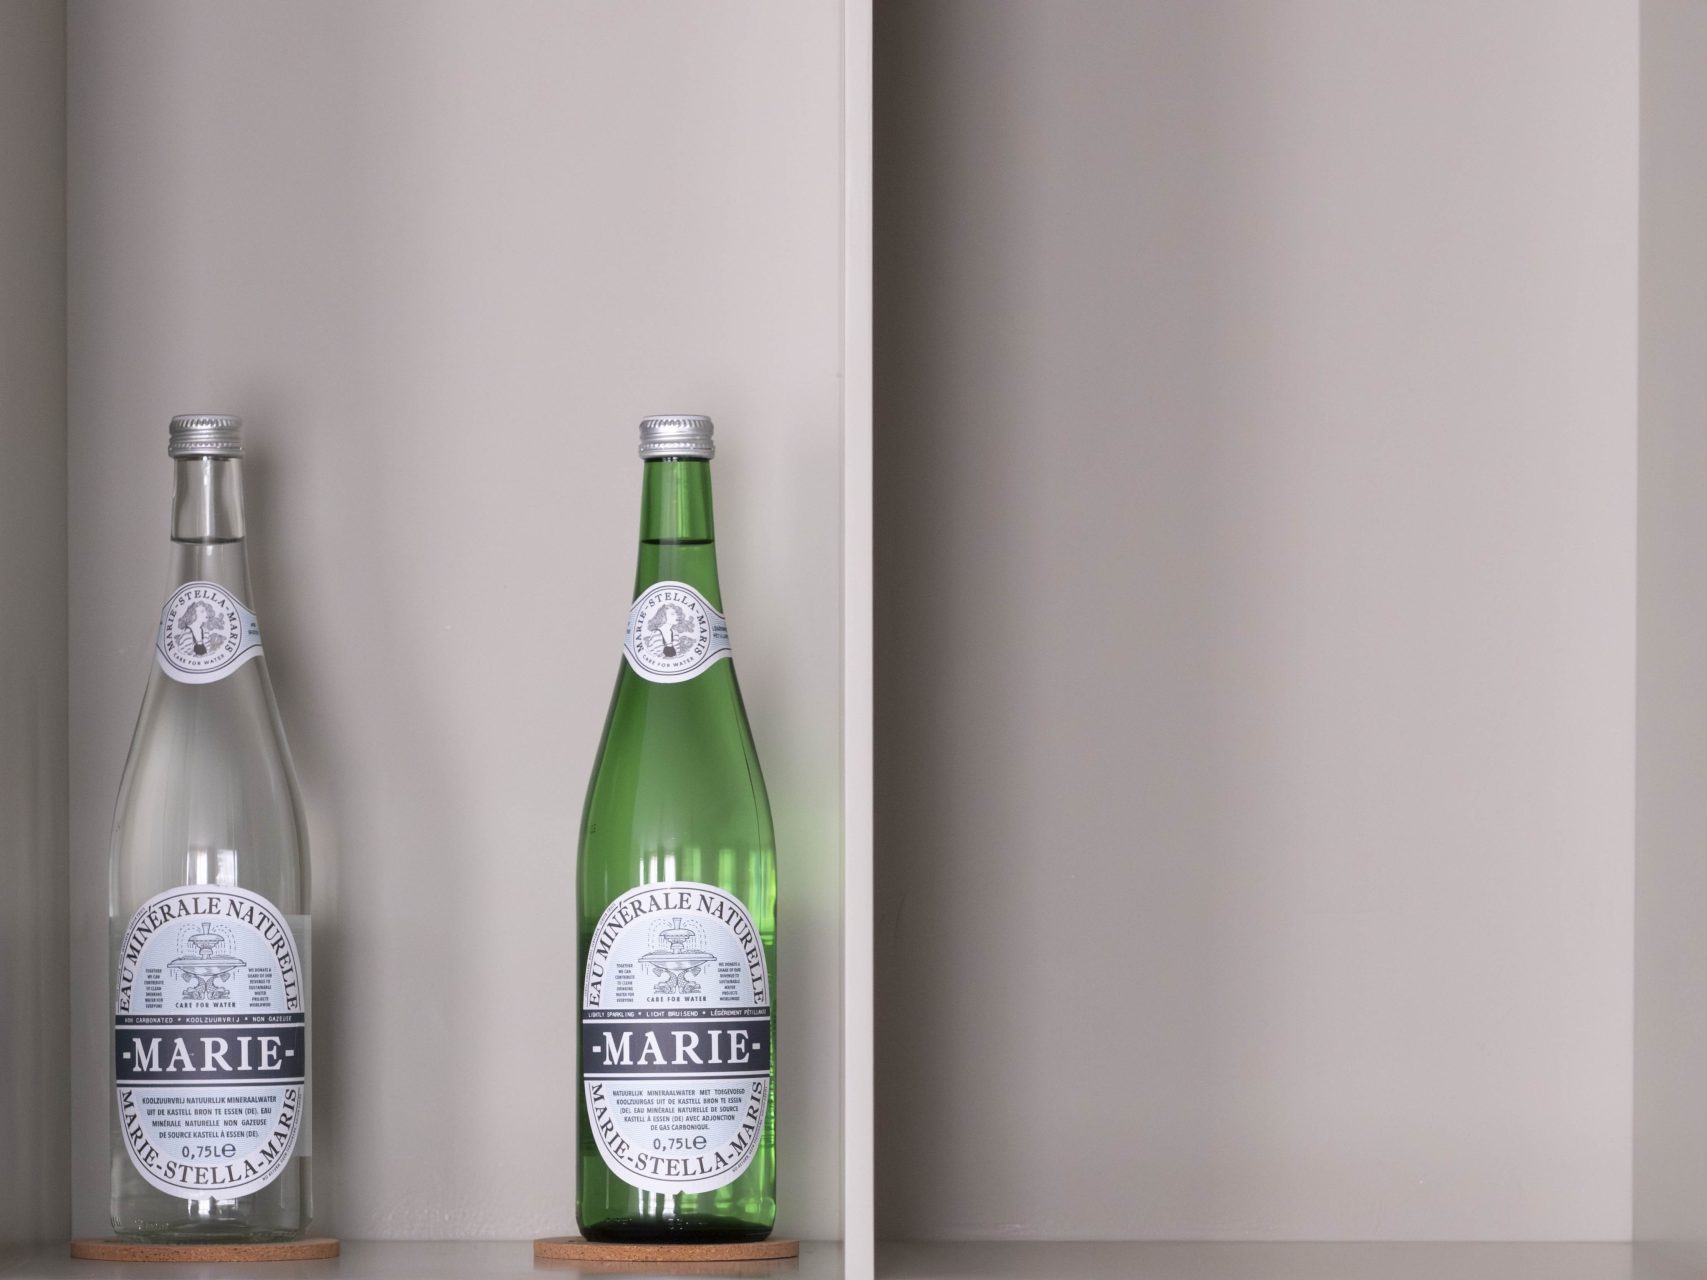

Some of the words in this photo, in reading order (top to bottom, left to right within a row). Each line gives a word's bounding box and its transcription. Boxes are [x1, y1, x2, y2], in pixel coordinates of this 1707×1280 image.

[166, 590, 238, 653] MARIE-STELLA-MARIS
[635, 592, 708, 655] MARIE-STELLA-MARIS
[120, 968, 134, 1013] EAU
[127, 896, 221, 966] MINÉRALE
[226, 899, 298, 1010] NATURELLE
[589, 962, 604, 1007] EAU
[597, 892, 692, 960] MINÉRALE
[697, 894, 764, 1004] NATURELLE
[122, 1088, 297, 1185] MARIE-STELLA-MARIS
[152, 1119, 182, 1127] MINÉRALE
[592, 1081, 762, 1177] MARIE-STELLA-MARIS
